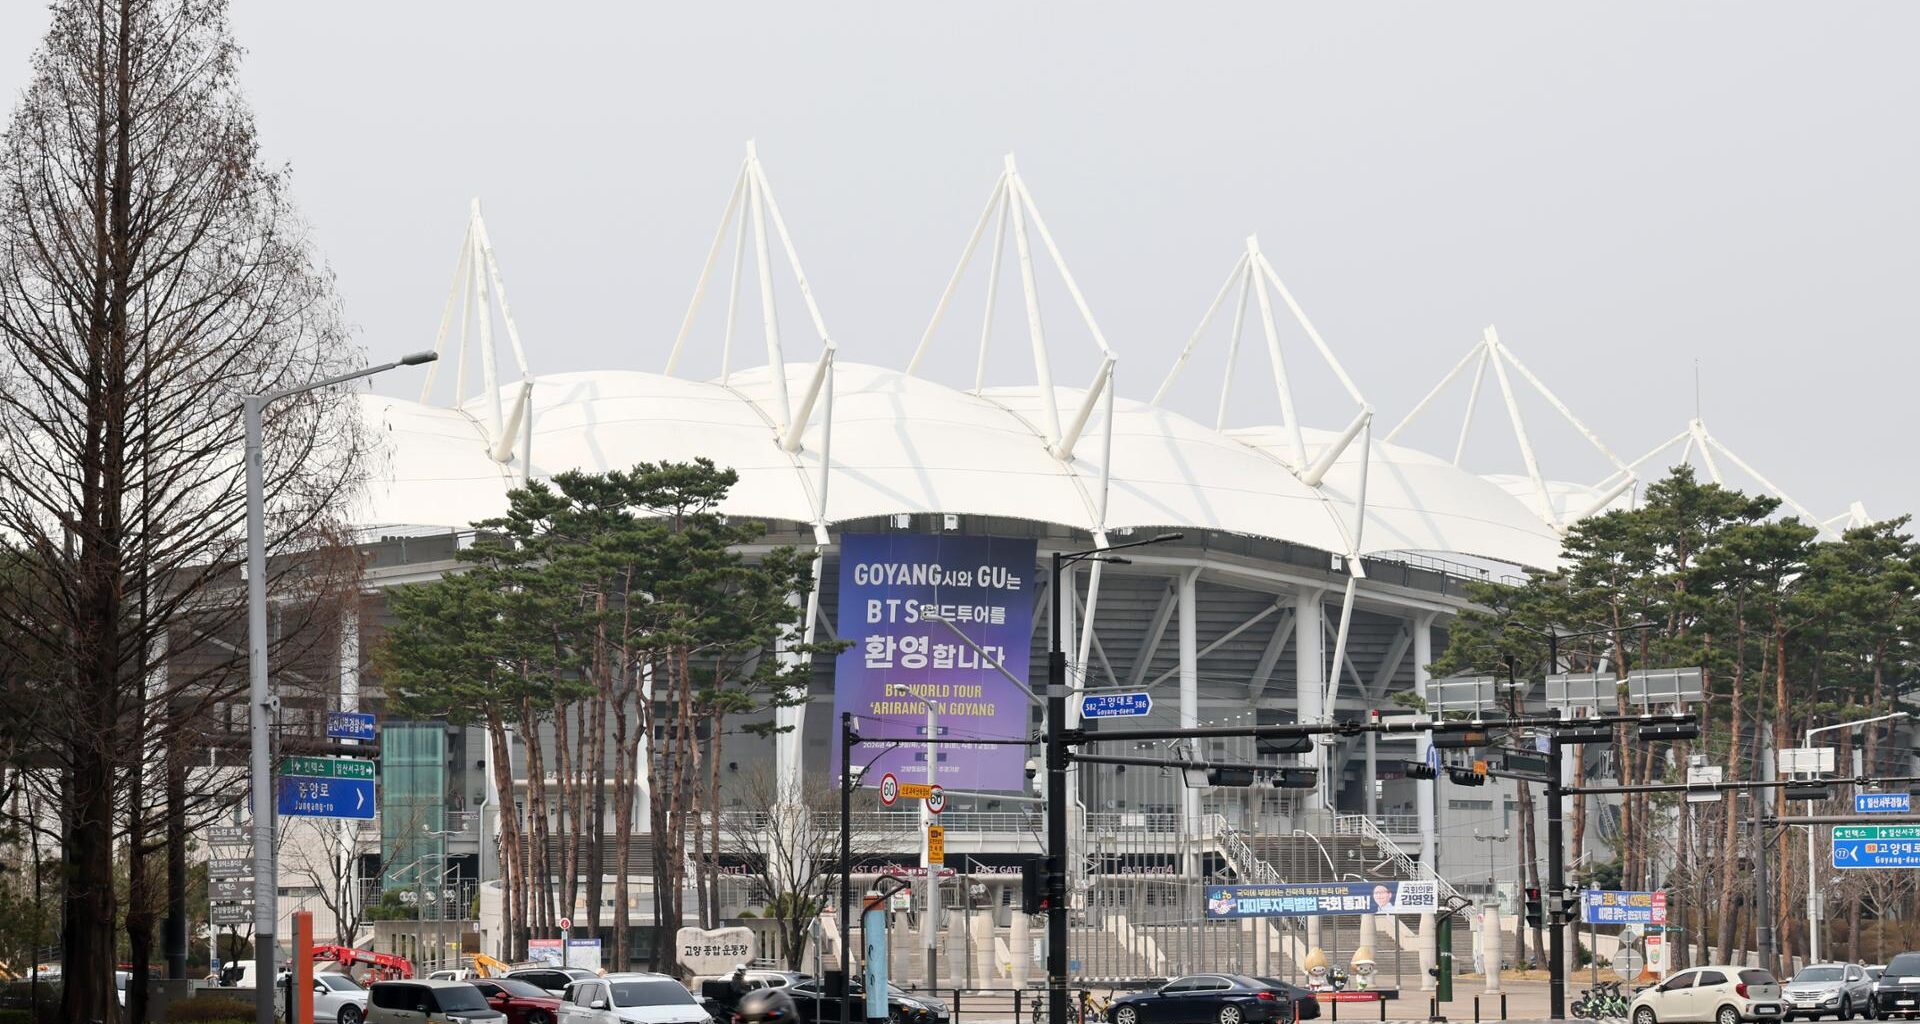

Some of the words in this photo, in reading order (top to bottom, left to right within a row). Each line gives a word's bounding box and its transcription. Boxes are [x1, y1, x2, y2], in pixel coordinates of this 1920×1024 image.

[854, 563, 972, 587] GOYANG시와
[977, 565, 1021, 590] GU는
[909, 684, 949, 698] WORLD
[953, 685, 982, 698] TOUR
[1098, 697, 1134, 707] 고양대로
[950, 703, 995, 717] GOYANG
[304, 762, 325, 773] 킨텍스
[336, 764, 366, 776] 일산서구청
[299, 782, 330, 799] 중앙로
[883, 782, 894, 796] 60
[1844, 829, 1867, 838] 킨텍스
[1000, 866, 1022, 874] GATE
[1403, 885, 1434, 894] 국회의원
[1237, 897, 1318, 913] 대미투자특별법
[1319, 896, 1342, 911] 국회
[1401, 894, 1434, 906] 김영환
[684, 945, 702, 956] 고양
[703, 945, 721, 956] 종합
[722, 944, 749, 956] 운동장
